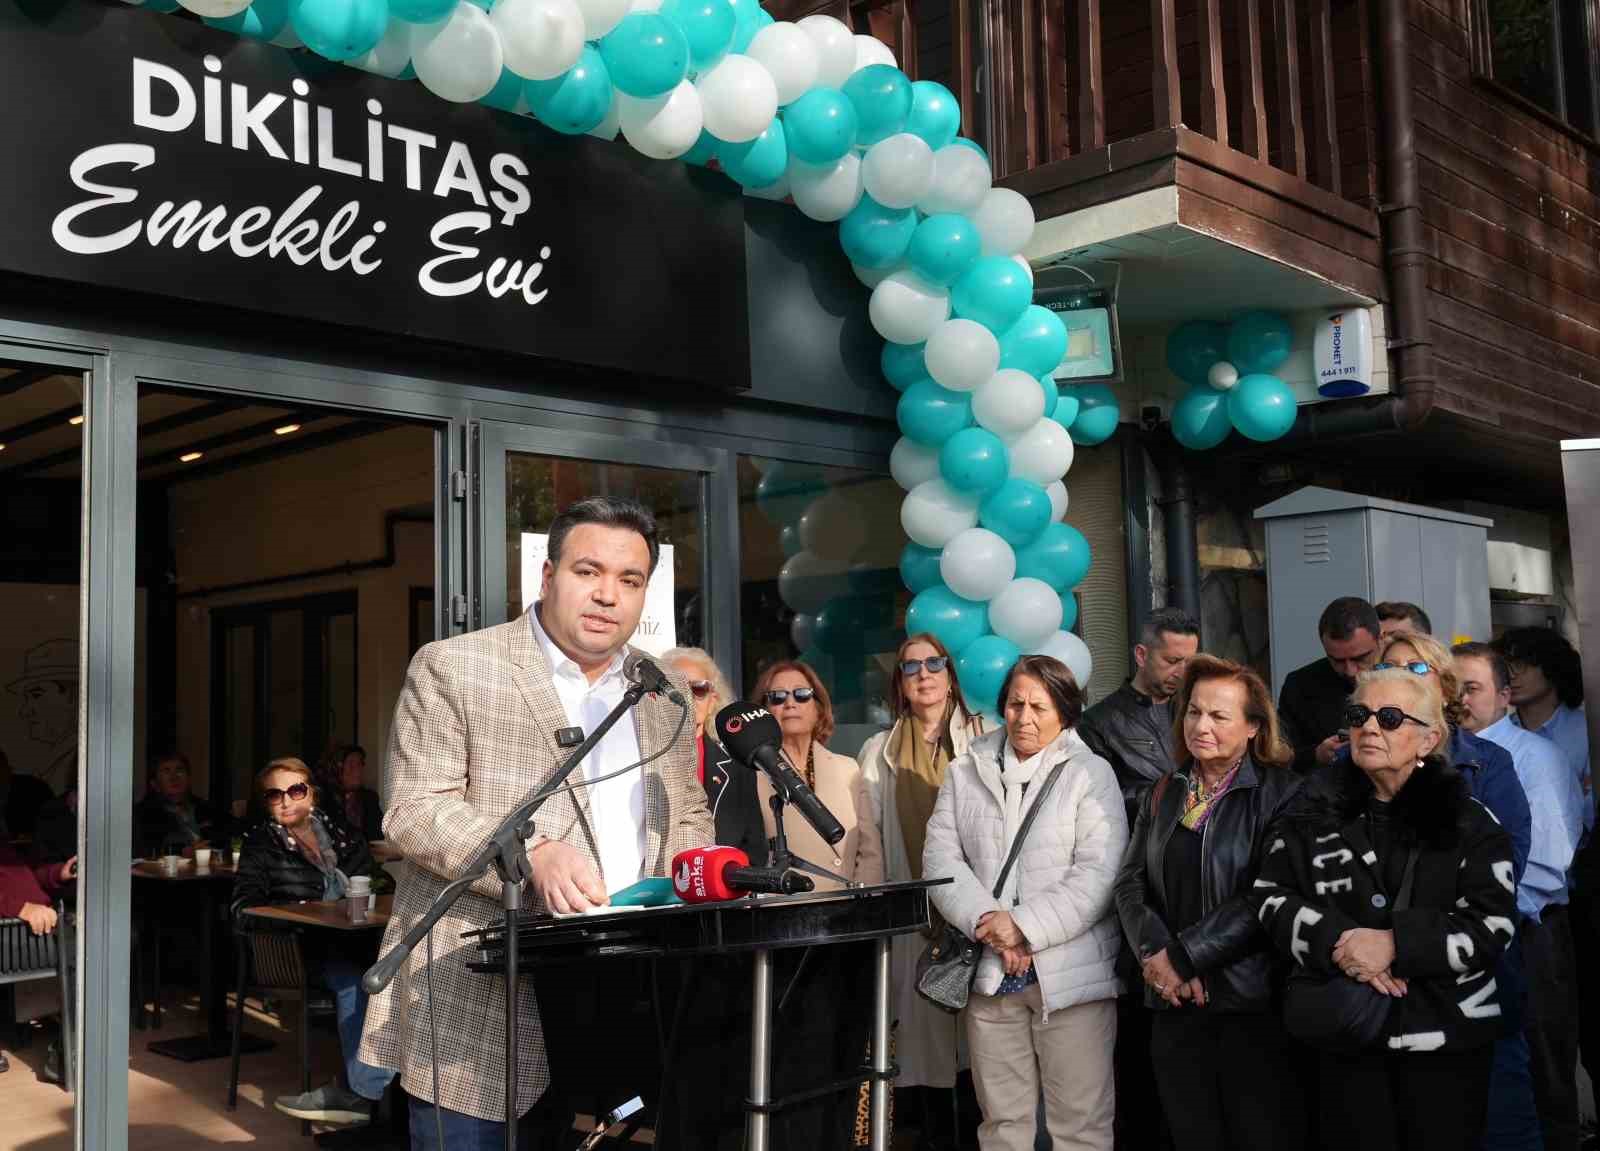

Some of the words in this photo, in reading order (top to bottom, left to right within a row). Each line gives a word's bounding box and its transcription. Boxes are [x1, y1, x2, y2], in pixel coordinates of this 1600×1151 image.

[133, 55, 530, 225] DİKİLİTAŞ
[52, 144, 386, 275] Emekli
[419, 211, 550, 304] Evi
[1321, 367, 1337, 377] 444
[1333, 326, 1342, 365] PRONET
